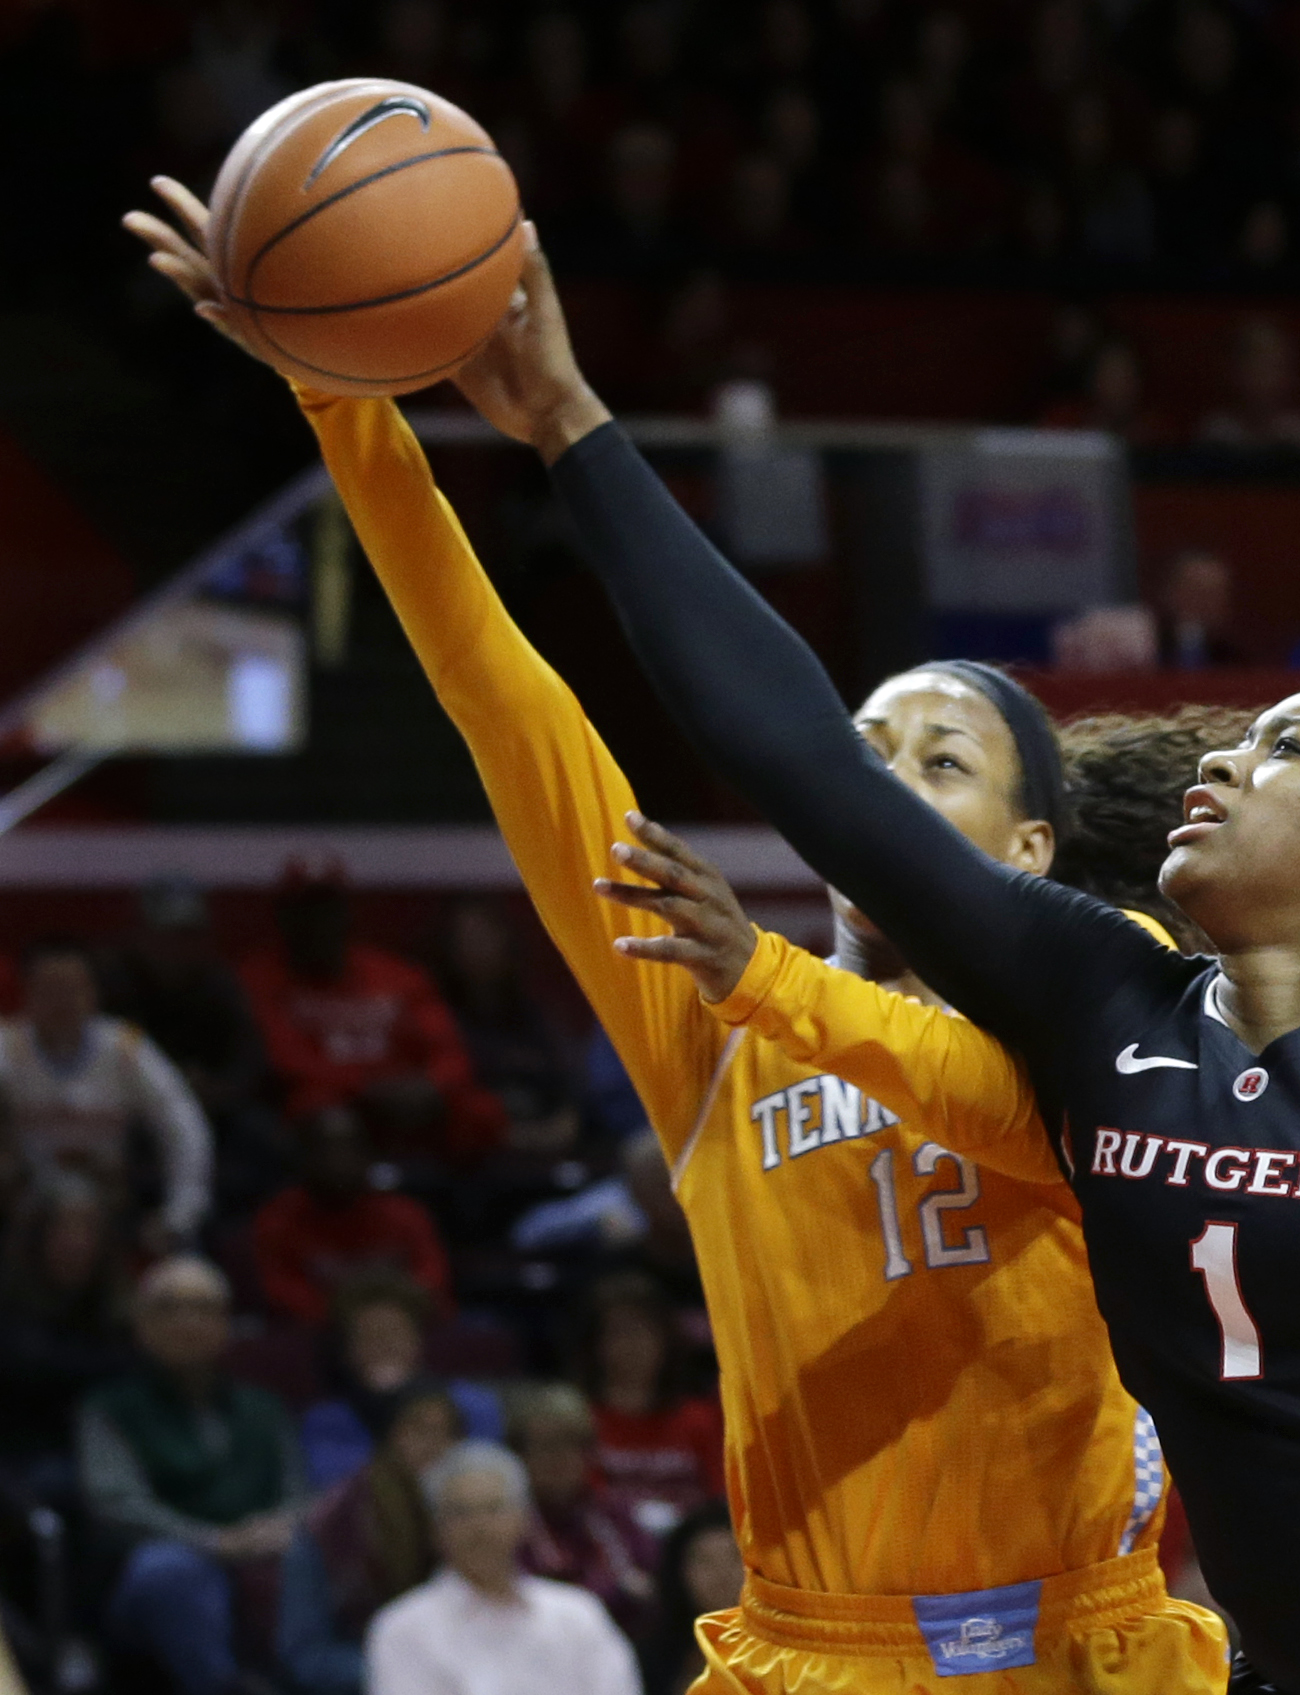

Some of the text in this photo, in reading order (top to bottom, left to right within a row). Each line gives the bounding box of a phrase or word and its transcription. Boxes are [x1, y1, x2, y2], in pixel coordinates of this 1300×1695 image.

[1239, 1074, 1261, 1093] R
[869, 1141, 991, 1282] 12
[1188, 1219, 1264, 1381] 1
